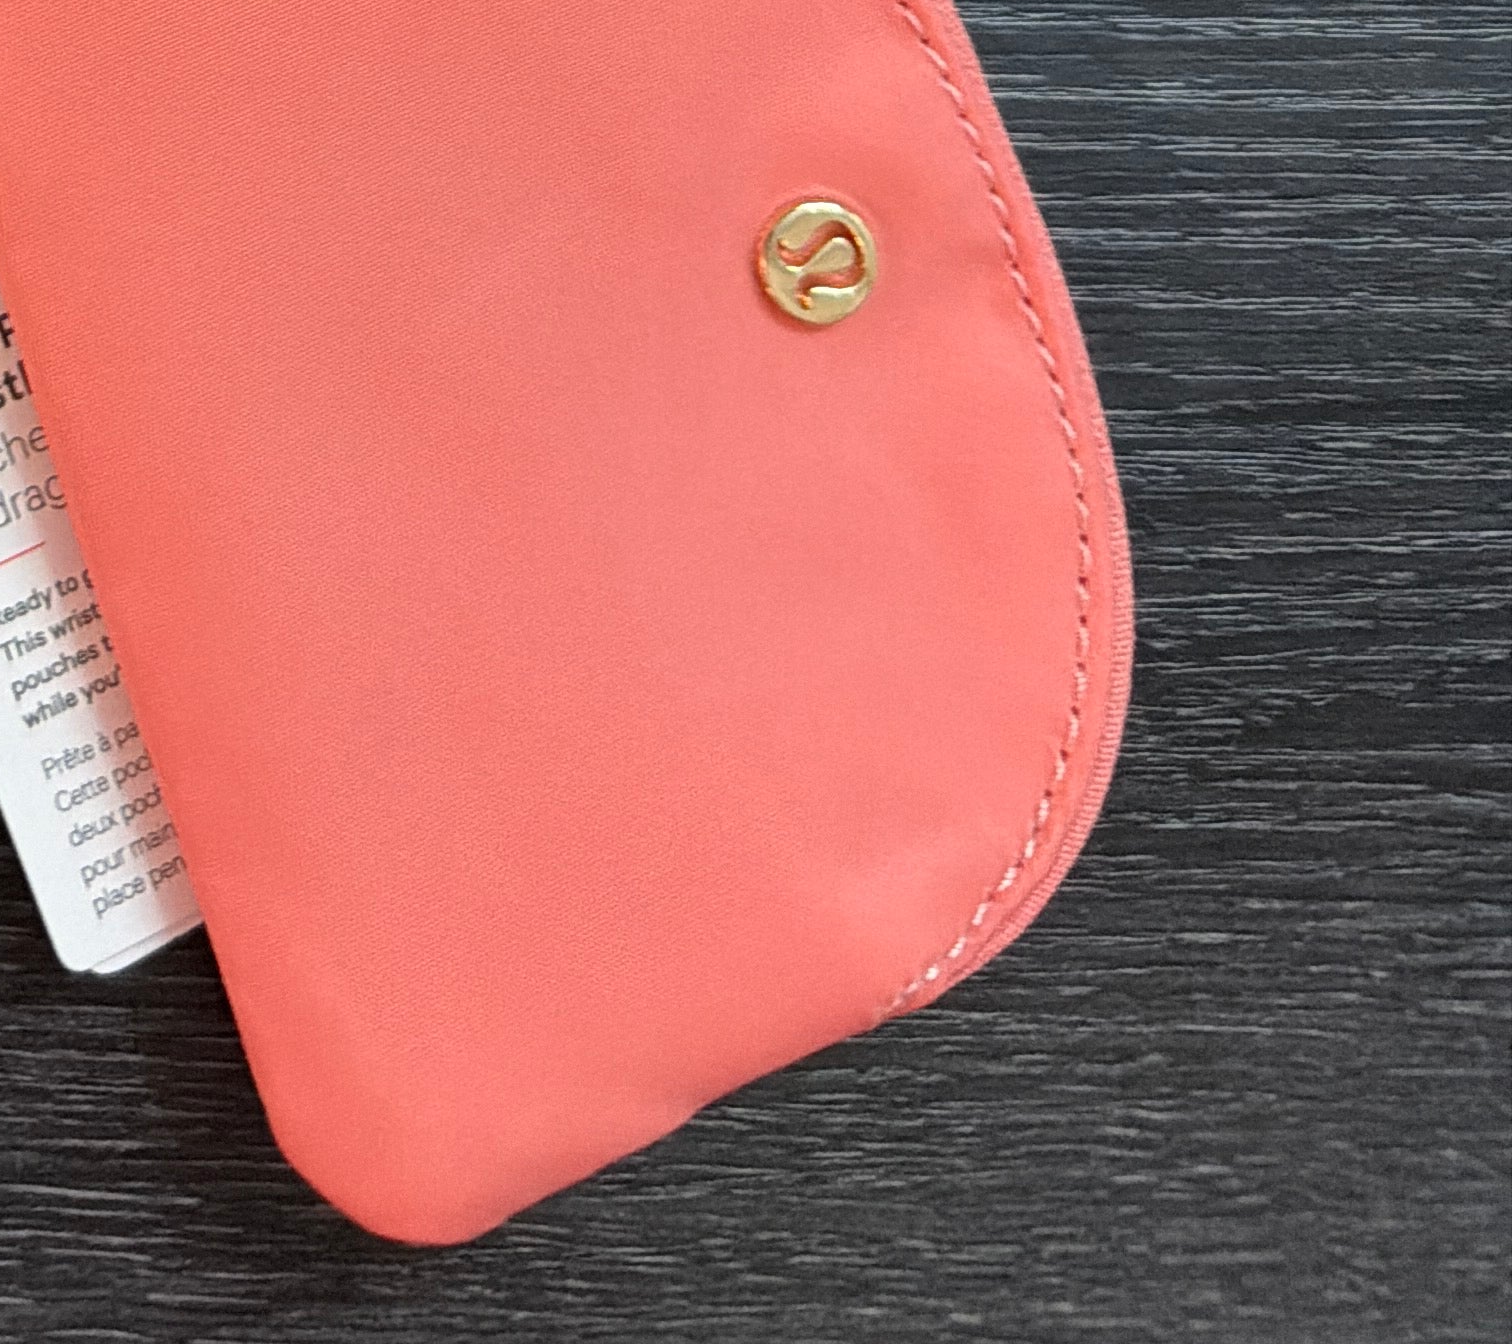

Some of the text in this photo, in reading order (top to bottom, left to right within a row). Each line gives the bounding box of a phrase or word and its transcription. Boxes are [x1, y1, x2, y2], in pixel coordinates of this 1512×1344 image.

[55, 577, 78, 597] to
[10, 644, 100, 701] pouches
[22, 692, 78, 728] while
[41, 744, 95, 780] Prête
[97, 733, 112, 753] à
[55, 776, 110, 812] Cette
[69, 815, 119, 847] deux
[81, 847, 125, 888] pour
[92, 877, 146, 919] place
